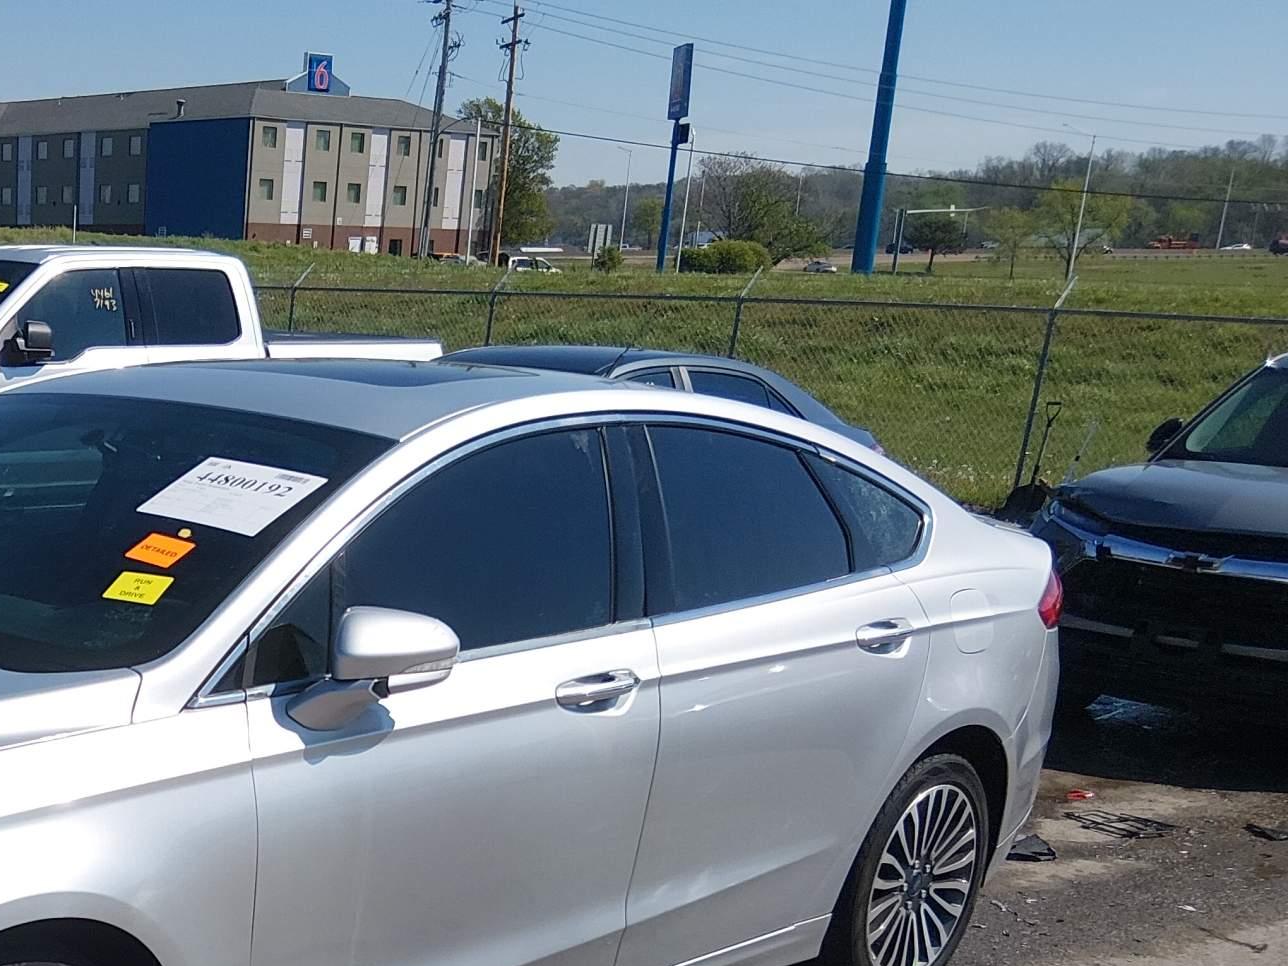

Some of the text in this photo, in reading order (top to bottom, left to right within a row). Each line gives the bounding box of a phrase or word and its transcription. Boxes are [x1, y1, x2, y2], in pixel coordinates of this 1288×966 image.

[314, 60, 329, 90] 6
[196, 472, 293, 498] 44800192
[140, 544, 178, 557] DETAILED
[134, 577, 153, 585] RUN
[119, 590, 145, 599] DRIVE
